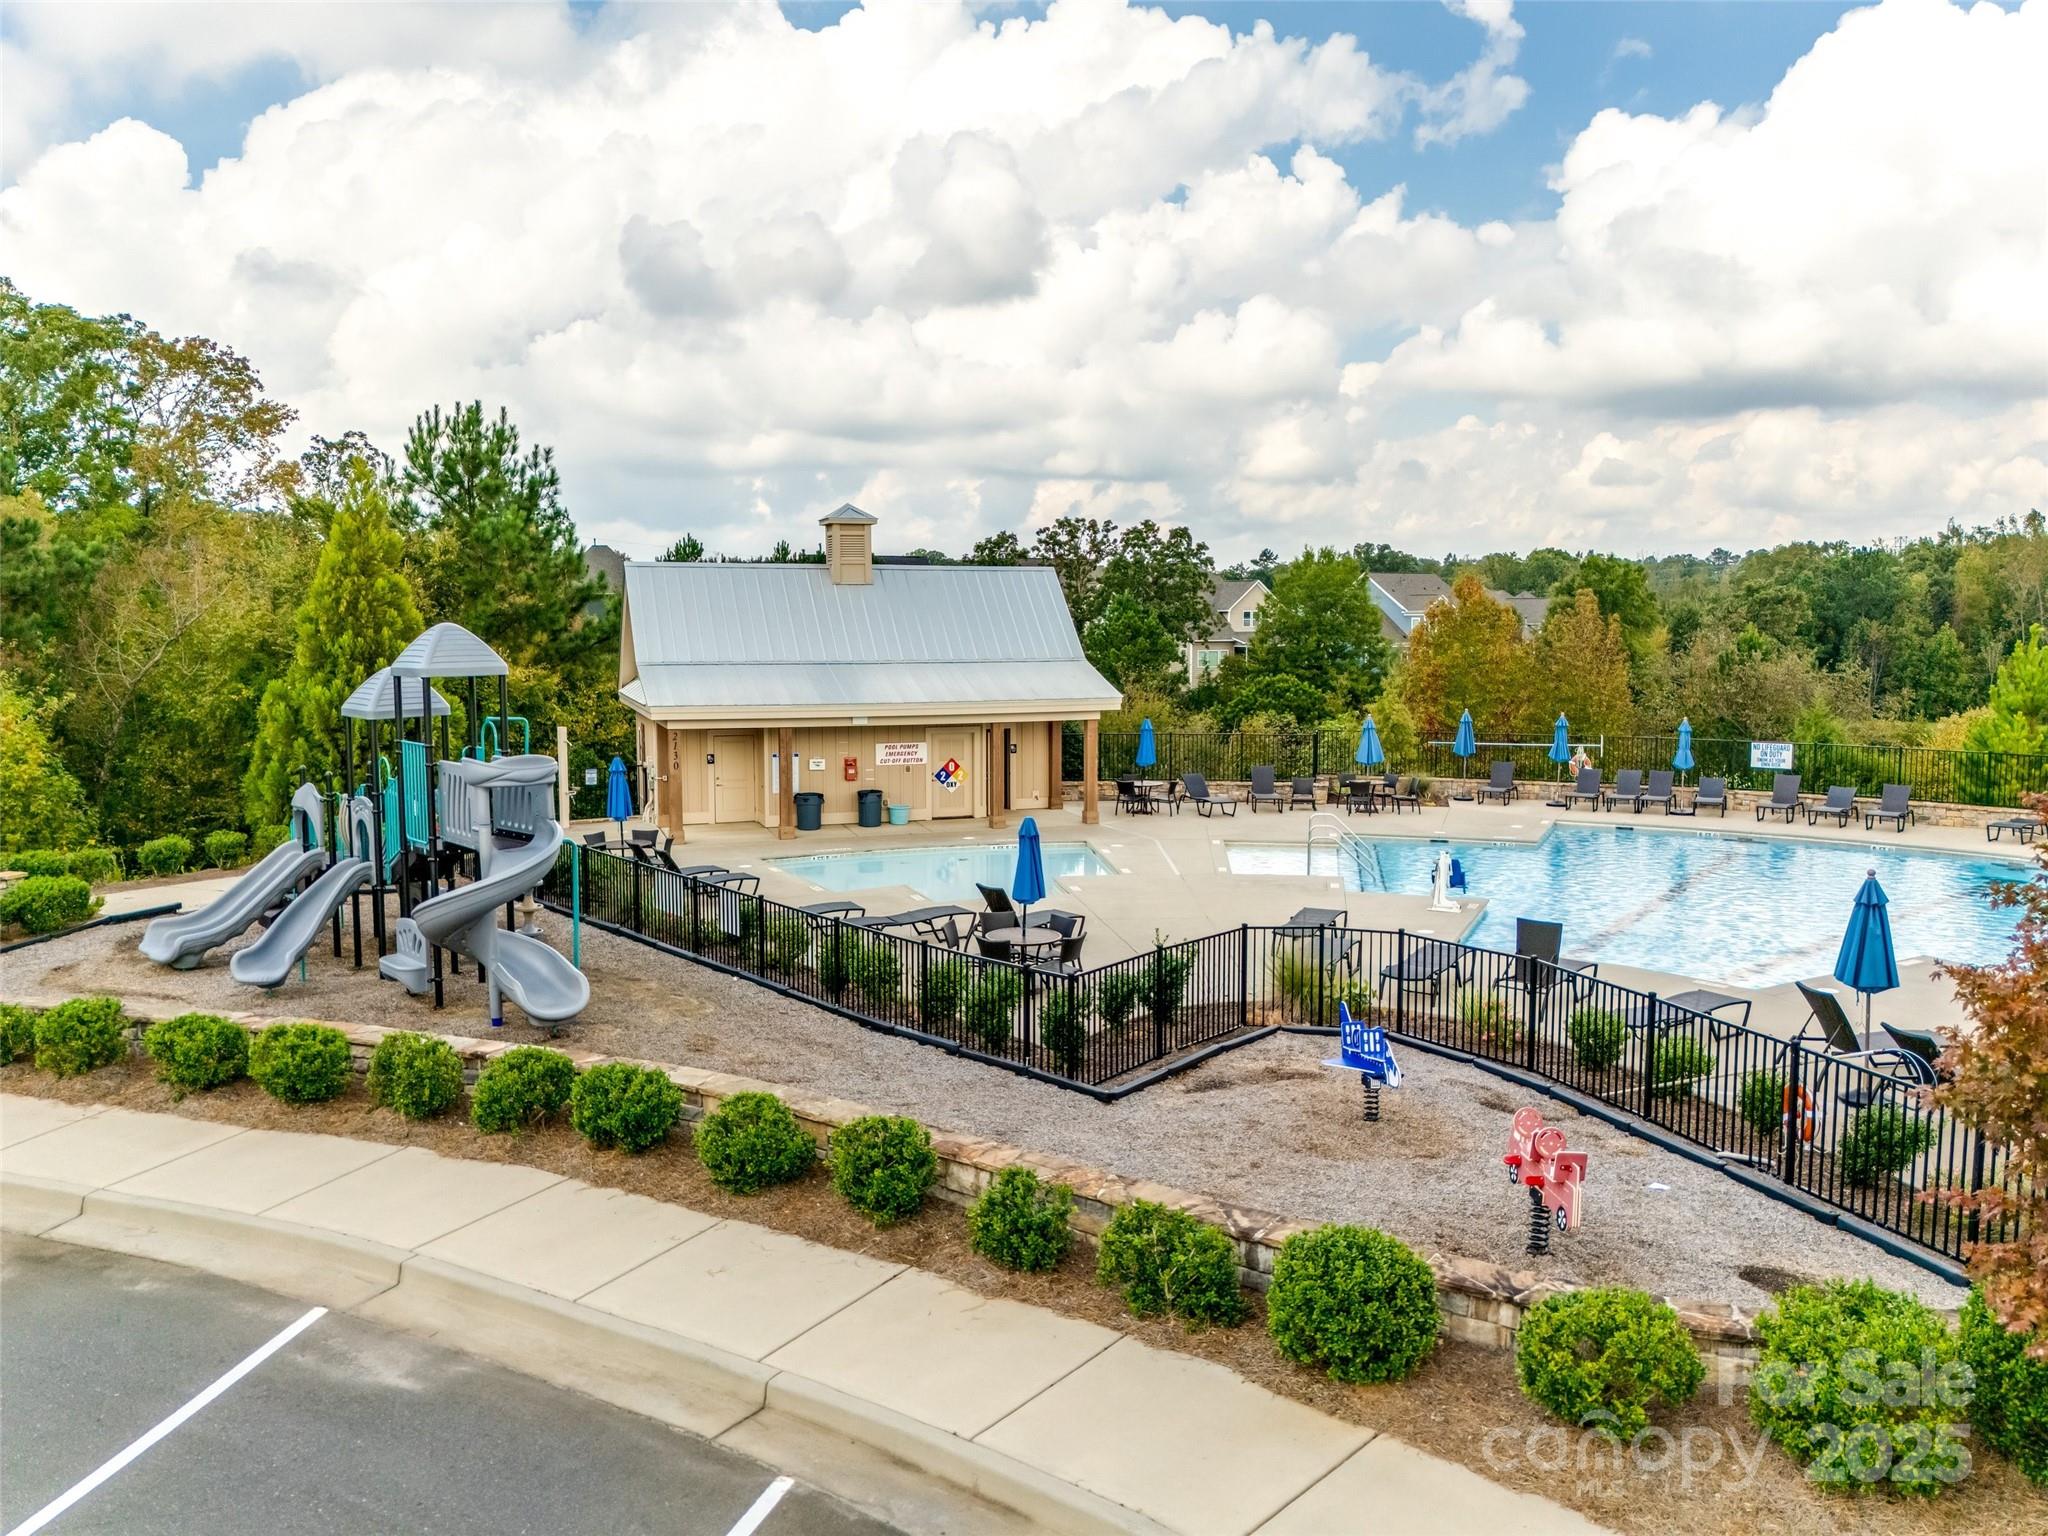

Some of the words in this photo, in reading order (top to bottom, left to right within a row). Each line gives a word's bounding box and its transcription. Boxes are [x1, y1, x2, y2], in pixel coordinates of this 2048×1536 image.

[1762, 744, 1790, 752] LIFEGUARD
[949, 761, 955, 771] 0
[940, 771, 946, 781] 2
[957, 770, 963, 780] 2
